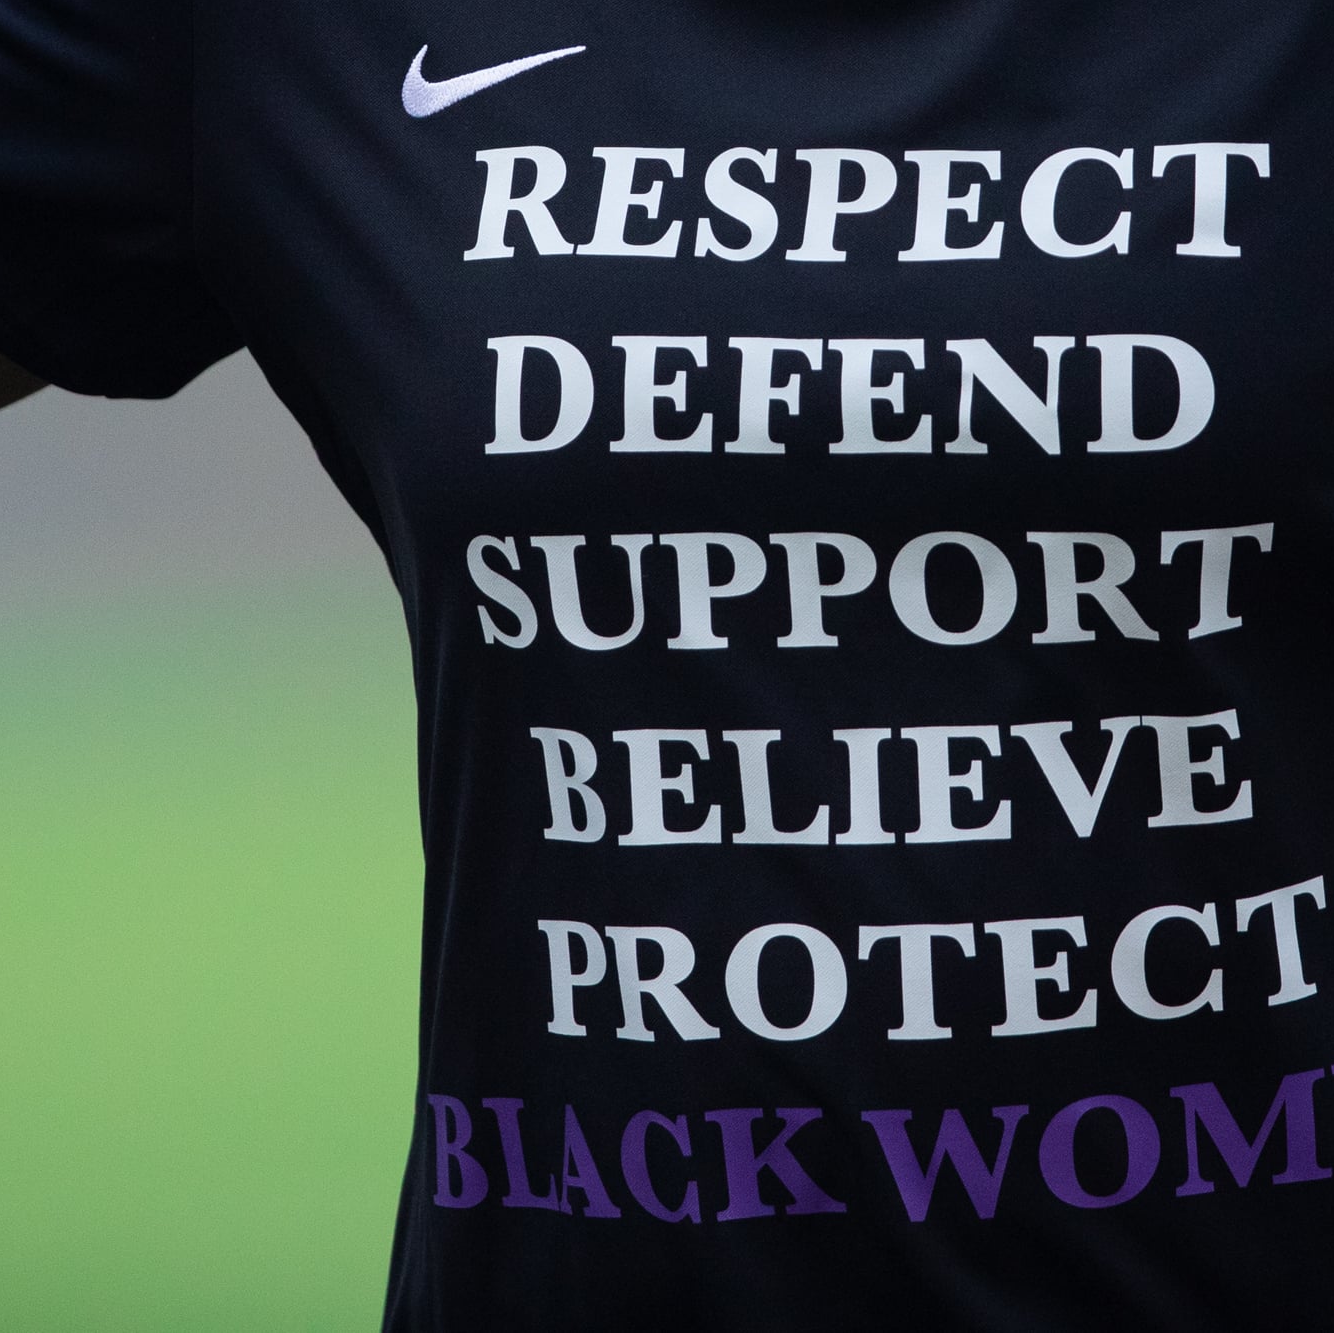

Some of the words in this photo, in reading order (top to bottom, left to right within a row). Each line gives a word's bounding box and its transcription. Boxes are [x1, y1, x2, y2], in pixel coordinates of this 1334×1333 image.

[464, 143, 1271, 262] RESPECT
[484, 334, 1215, 455] DEFEND
[466, 523, 1274, 651] SUPPORT
[529, 709, 1255, 846] BELIEVE
[537, 876, 1327, 1042] PROTECT
[428, 1093, 847, 1226] BLACK
